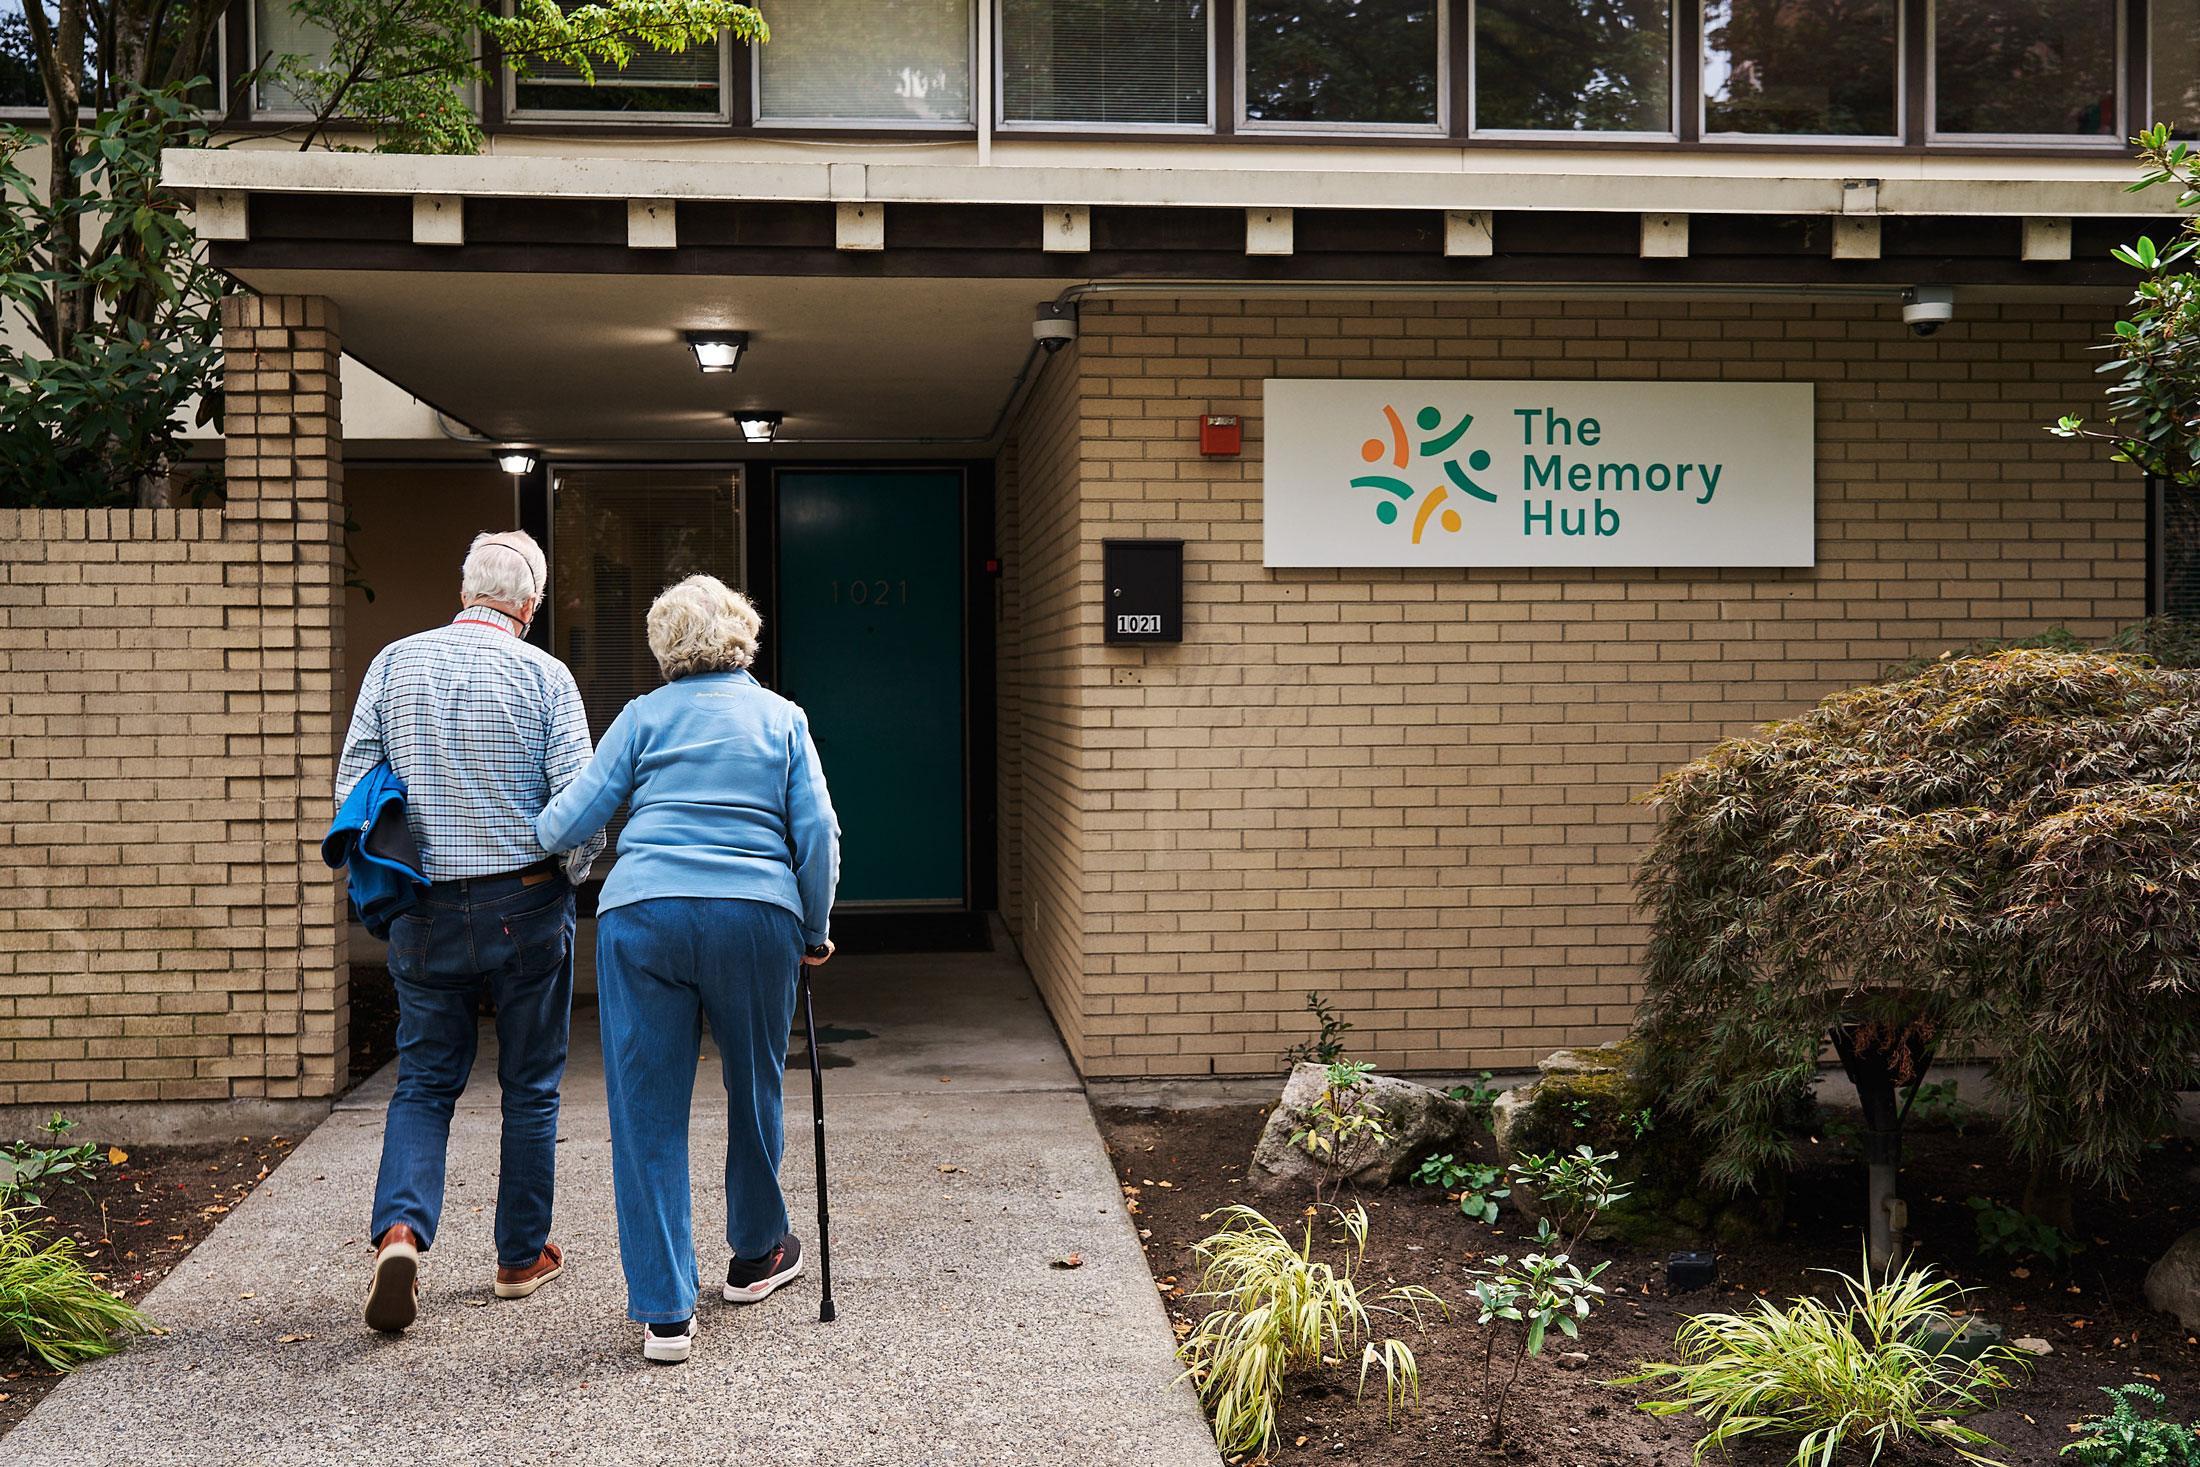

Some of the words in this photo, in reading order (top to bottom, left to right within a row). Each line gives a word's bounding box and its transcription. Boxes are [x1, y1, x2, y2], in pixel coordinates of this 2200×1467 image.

[1513, 407, 1602, 447] The
[1523, 454, 1723, 506] Memory
[1523, 498, 1621, 538] Hub
[831, 579, 907, 606] 1021
[1118, 615, 1161, 634] 1021
